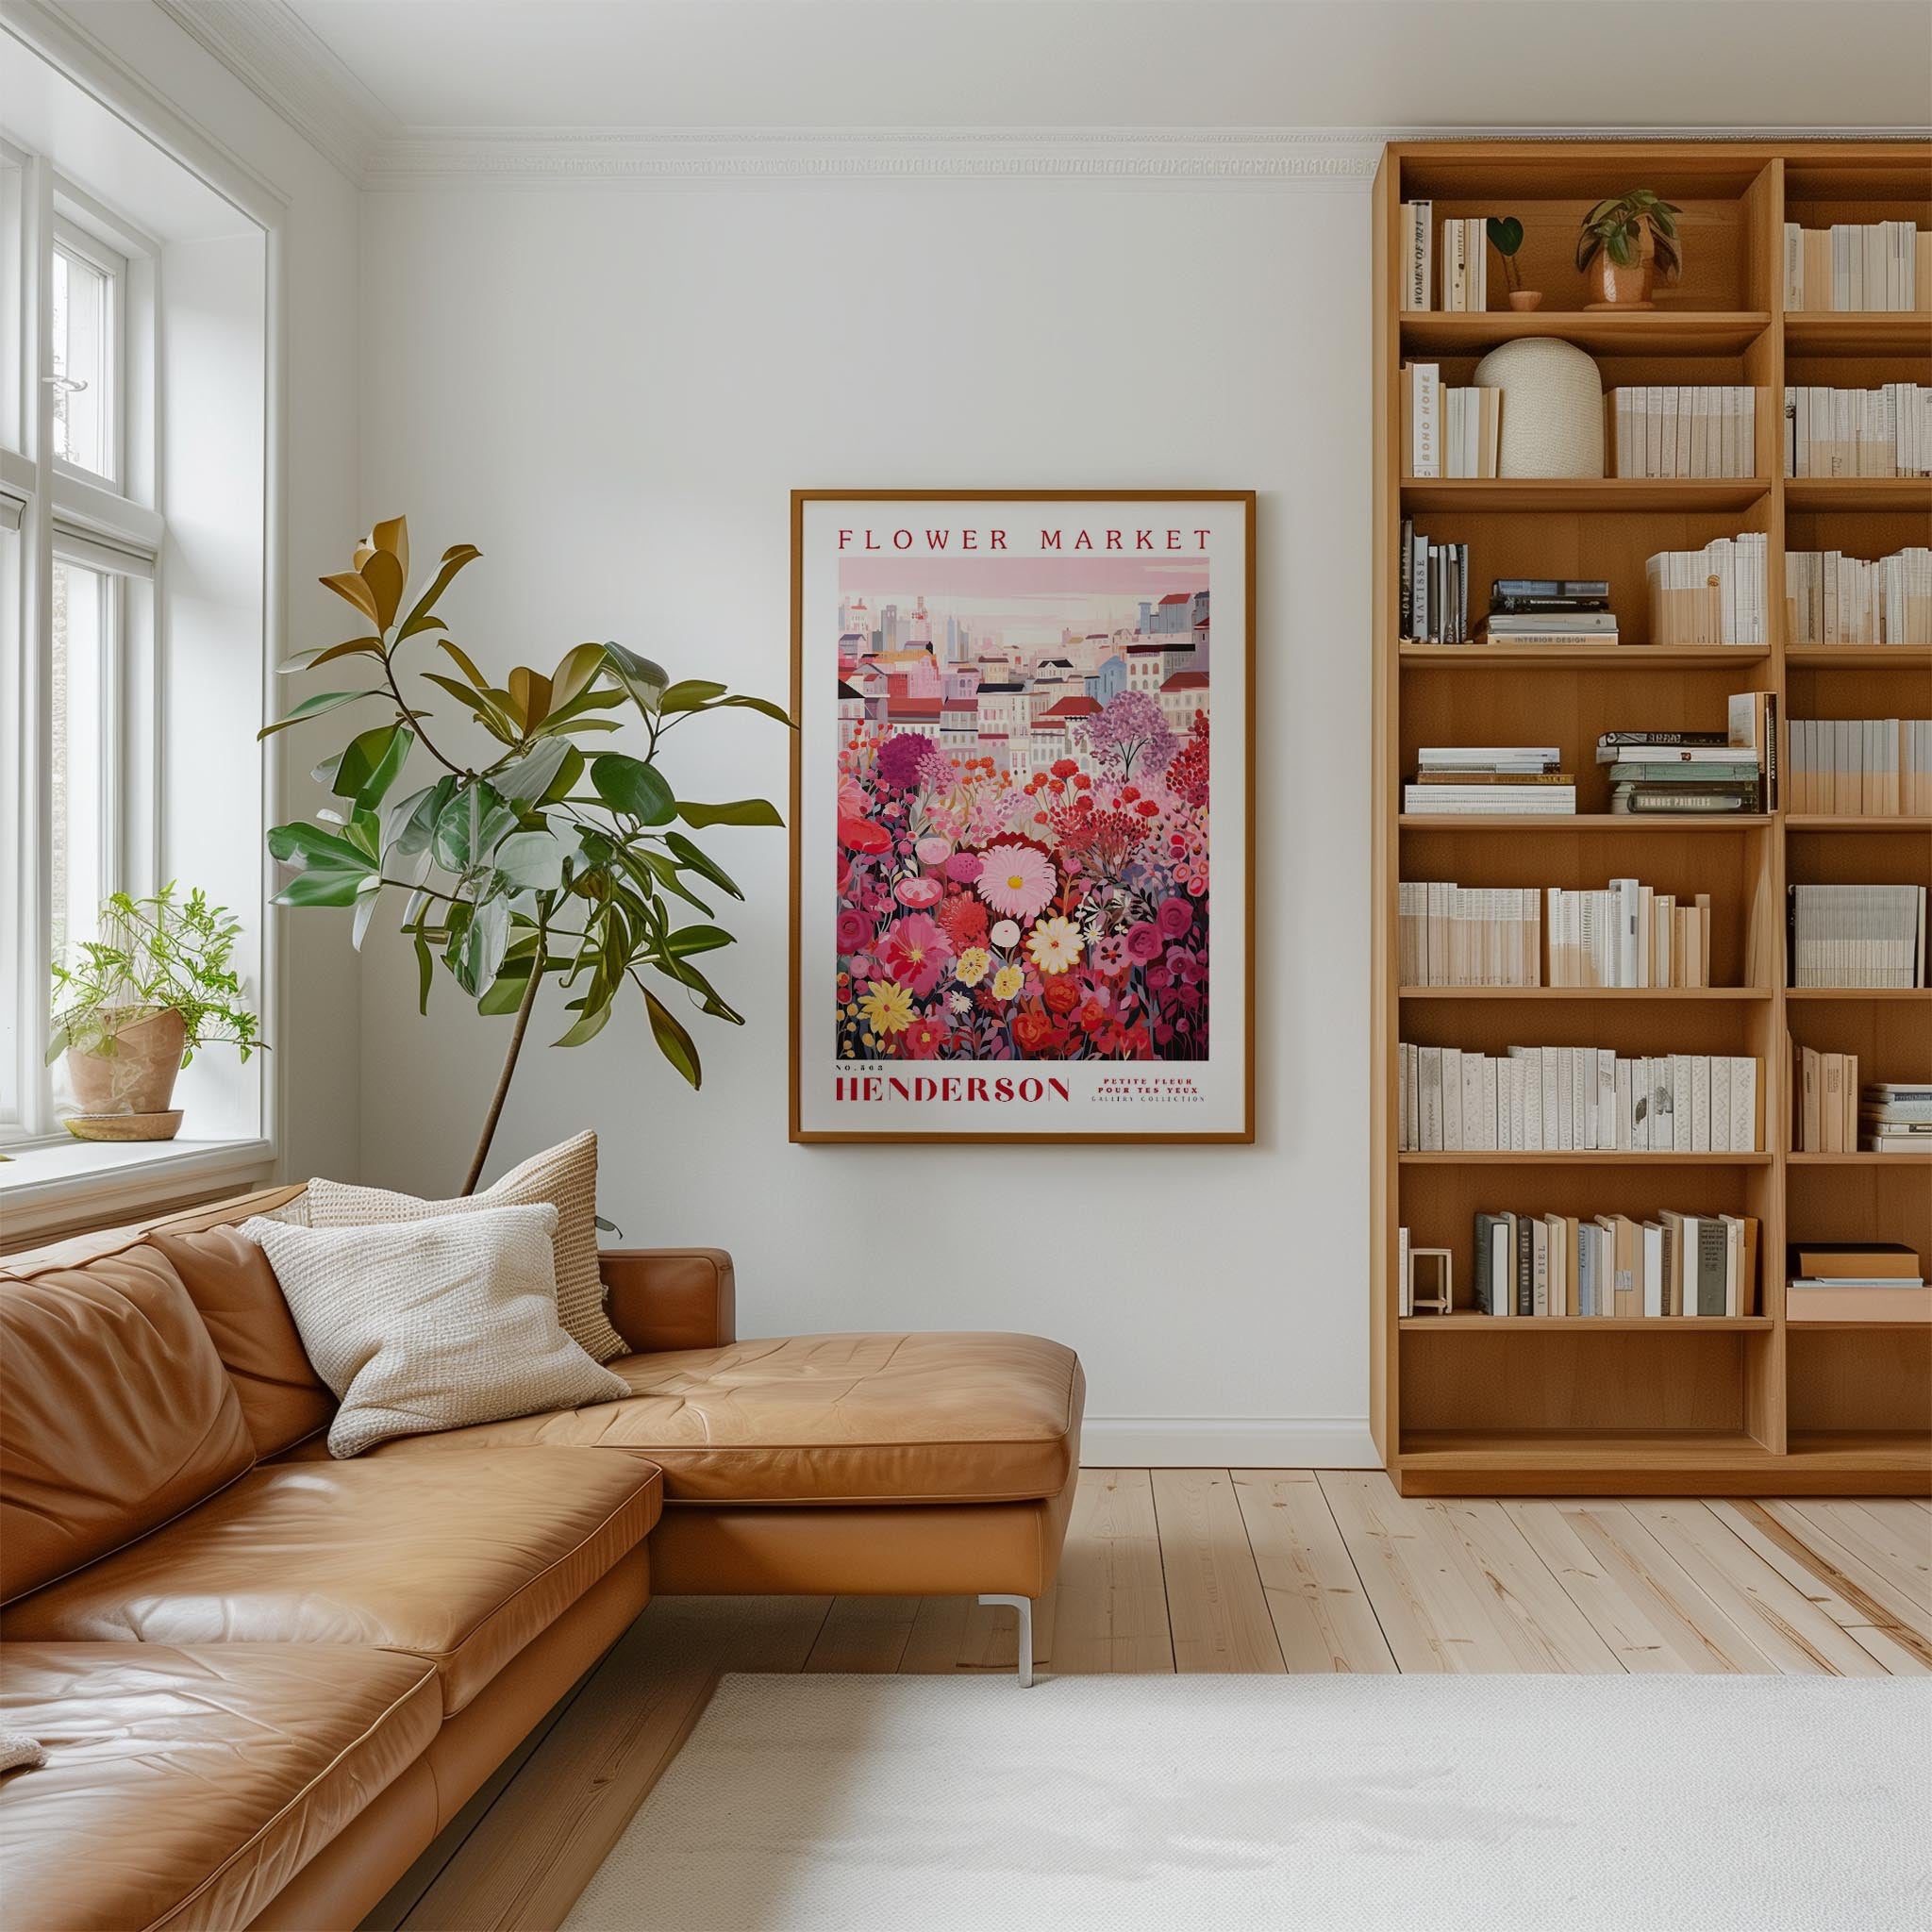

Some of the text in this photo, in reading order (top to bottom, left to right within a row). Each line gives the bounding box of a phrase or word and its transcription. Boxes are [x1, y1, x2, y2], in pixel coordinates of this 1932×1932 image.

[1415, 245, 1424, 260] OF
[1414, 263, 1424, 305] WOMEN
[1422, 375, 1430, 461] BOHO HOME
[839, 529, 1210, 550] FLOWER MARKET
[1416, 559, 1424, 624] MATISSE
[1640, 798, 1711, 807] FAMOUS PAINTERS
[836, 1077, 1069, 1102] HENDERSON
[1537, 1283, 1545, 1305] IVY
